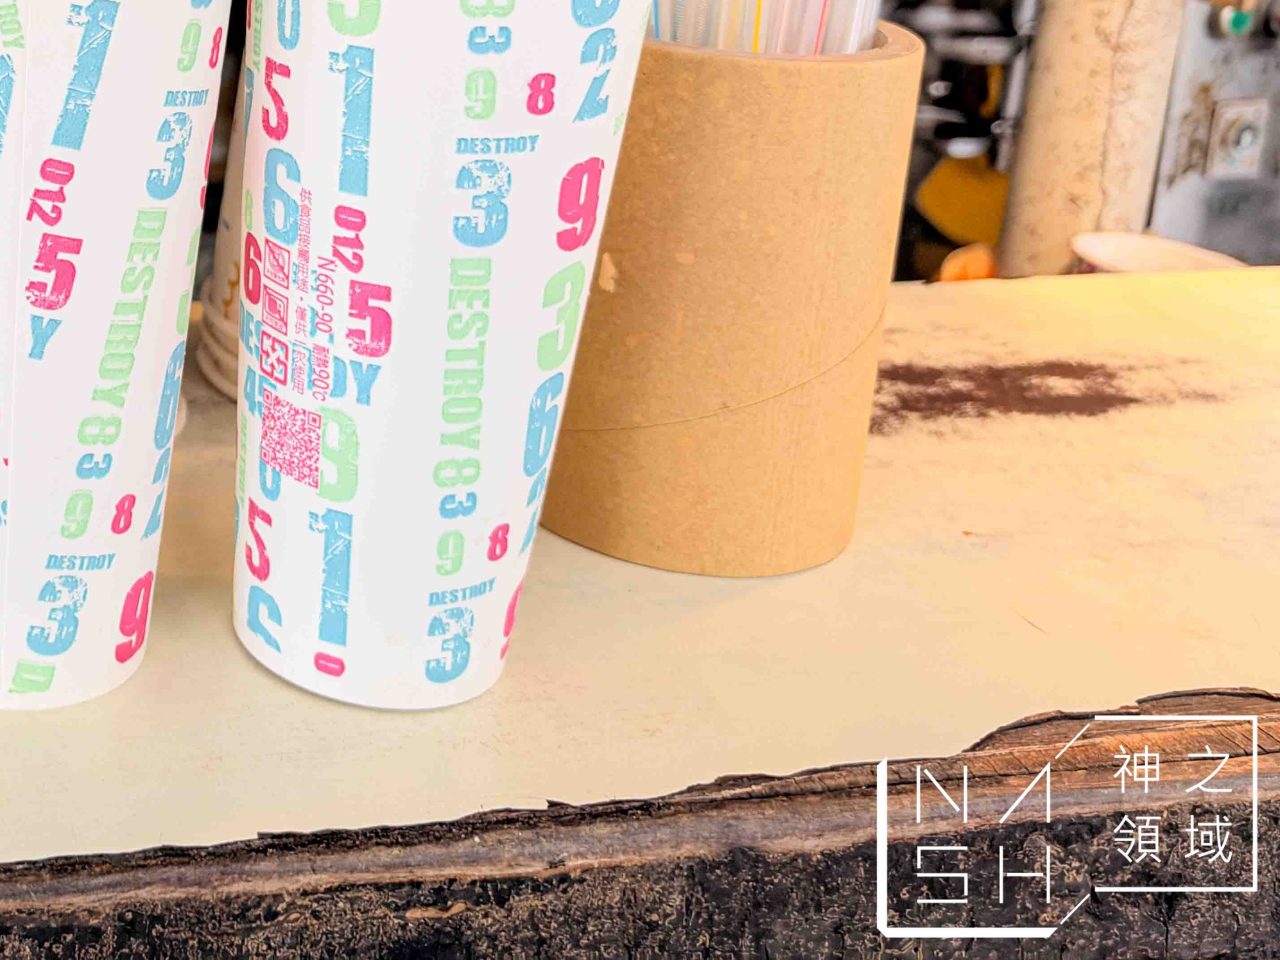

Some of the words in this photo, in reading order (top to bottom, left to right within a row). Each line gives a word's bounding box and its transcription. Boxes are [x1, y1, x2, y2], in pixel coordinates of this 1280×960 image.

[162, 88, 210, 107] DESTROY
[525, 72, 557, 116] 8
[456, 135, 538, 155] DESTROY
[555, 156, 606, 253] 9
[110, 493, 137, 536] 8
[486, 523, 510, 562] 8
[46, 554, 114, 571] DESTROY
[428, 580, 494, 606] DESTROY
